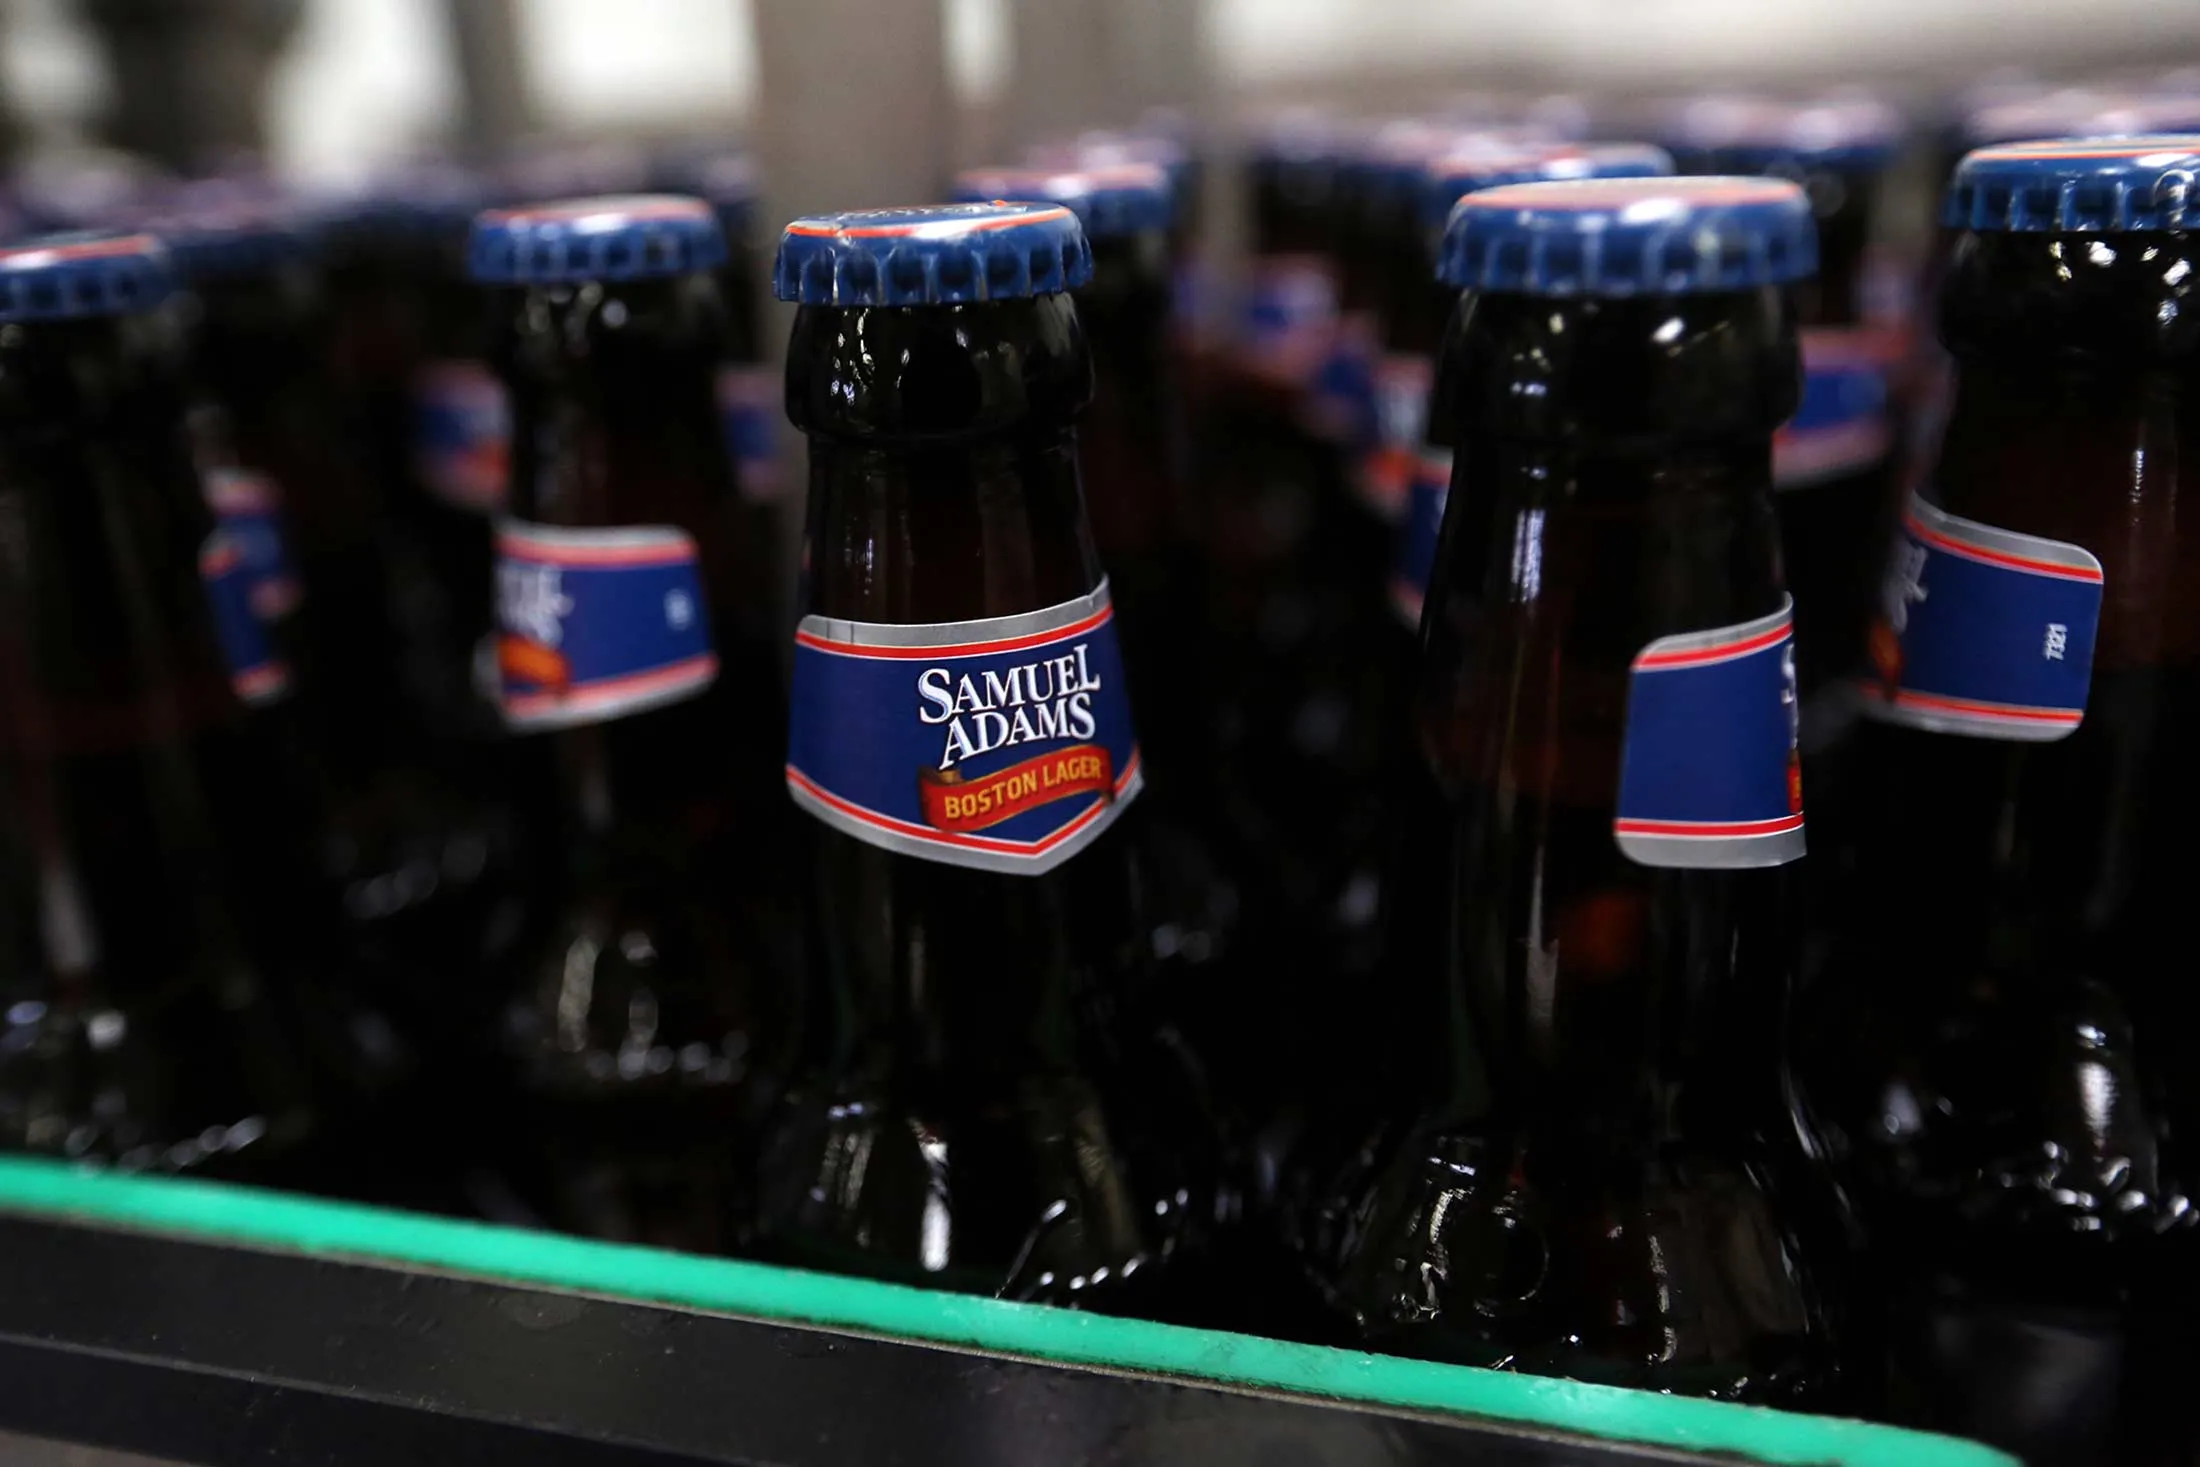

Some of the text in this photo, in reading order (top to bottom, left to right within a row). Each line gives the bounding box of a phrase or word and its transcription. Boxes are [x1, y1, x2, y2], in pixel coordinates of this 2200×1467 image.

[917, 643, 1101, 724] SAMUEL
[939, 692, 1096, 771] ADAMS
[944, 755, 1102, 819] BOSTON LAGER
